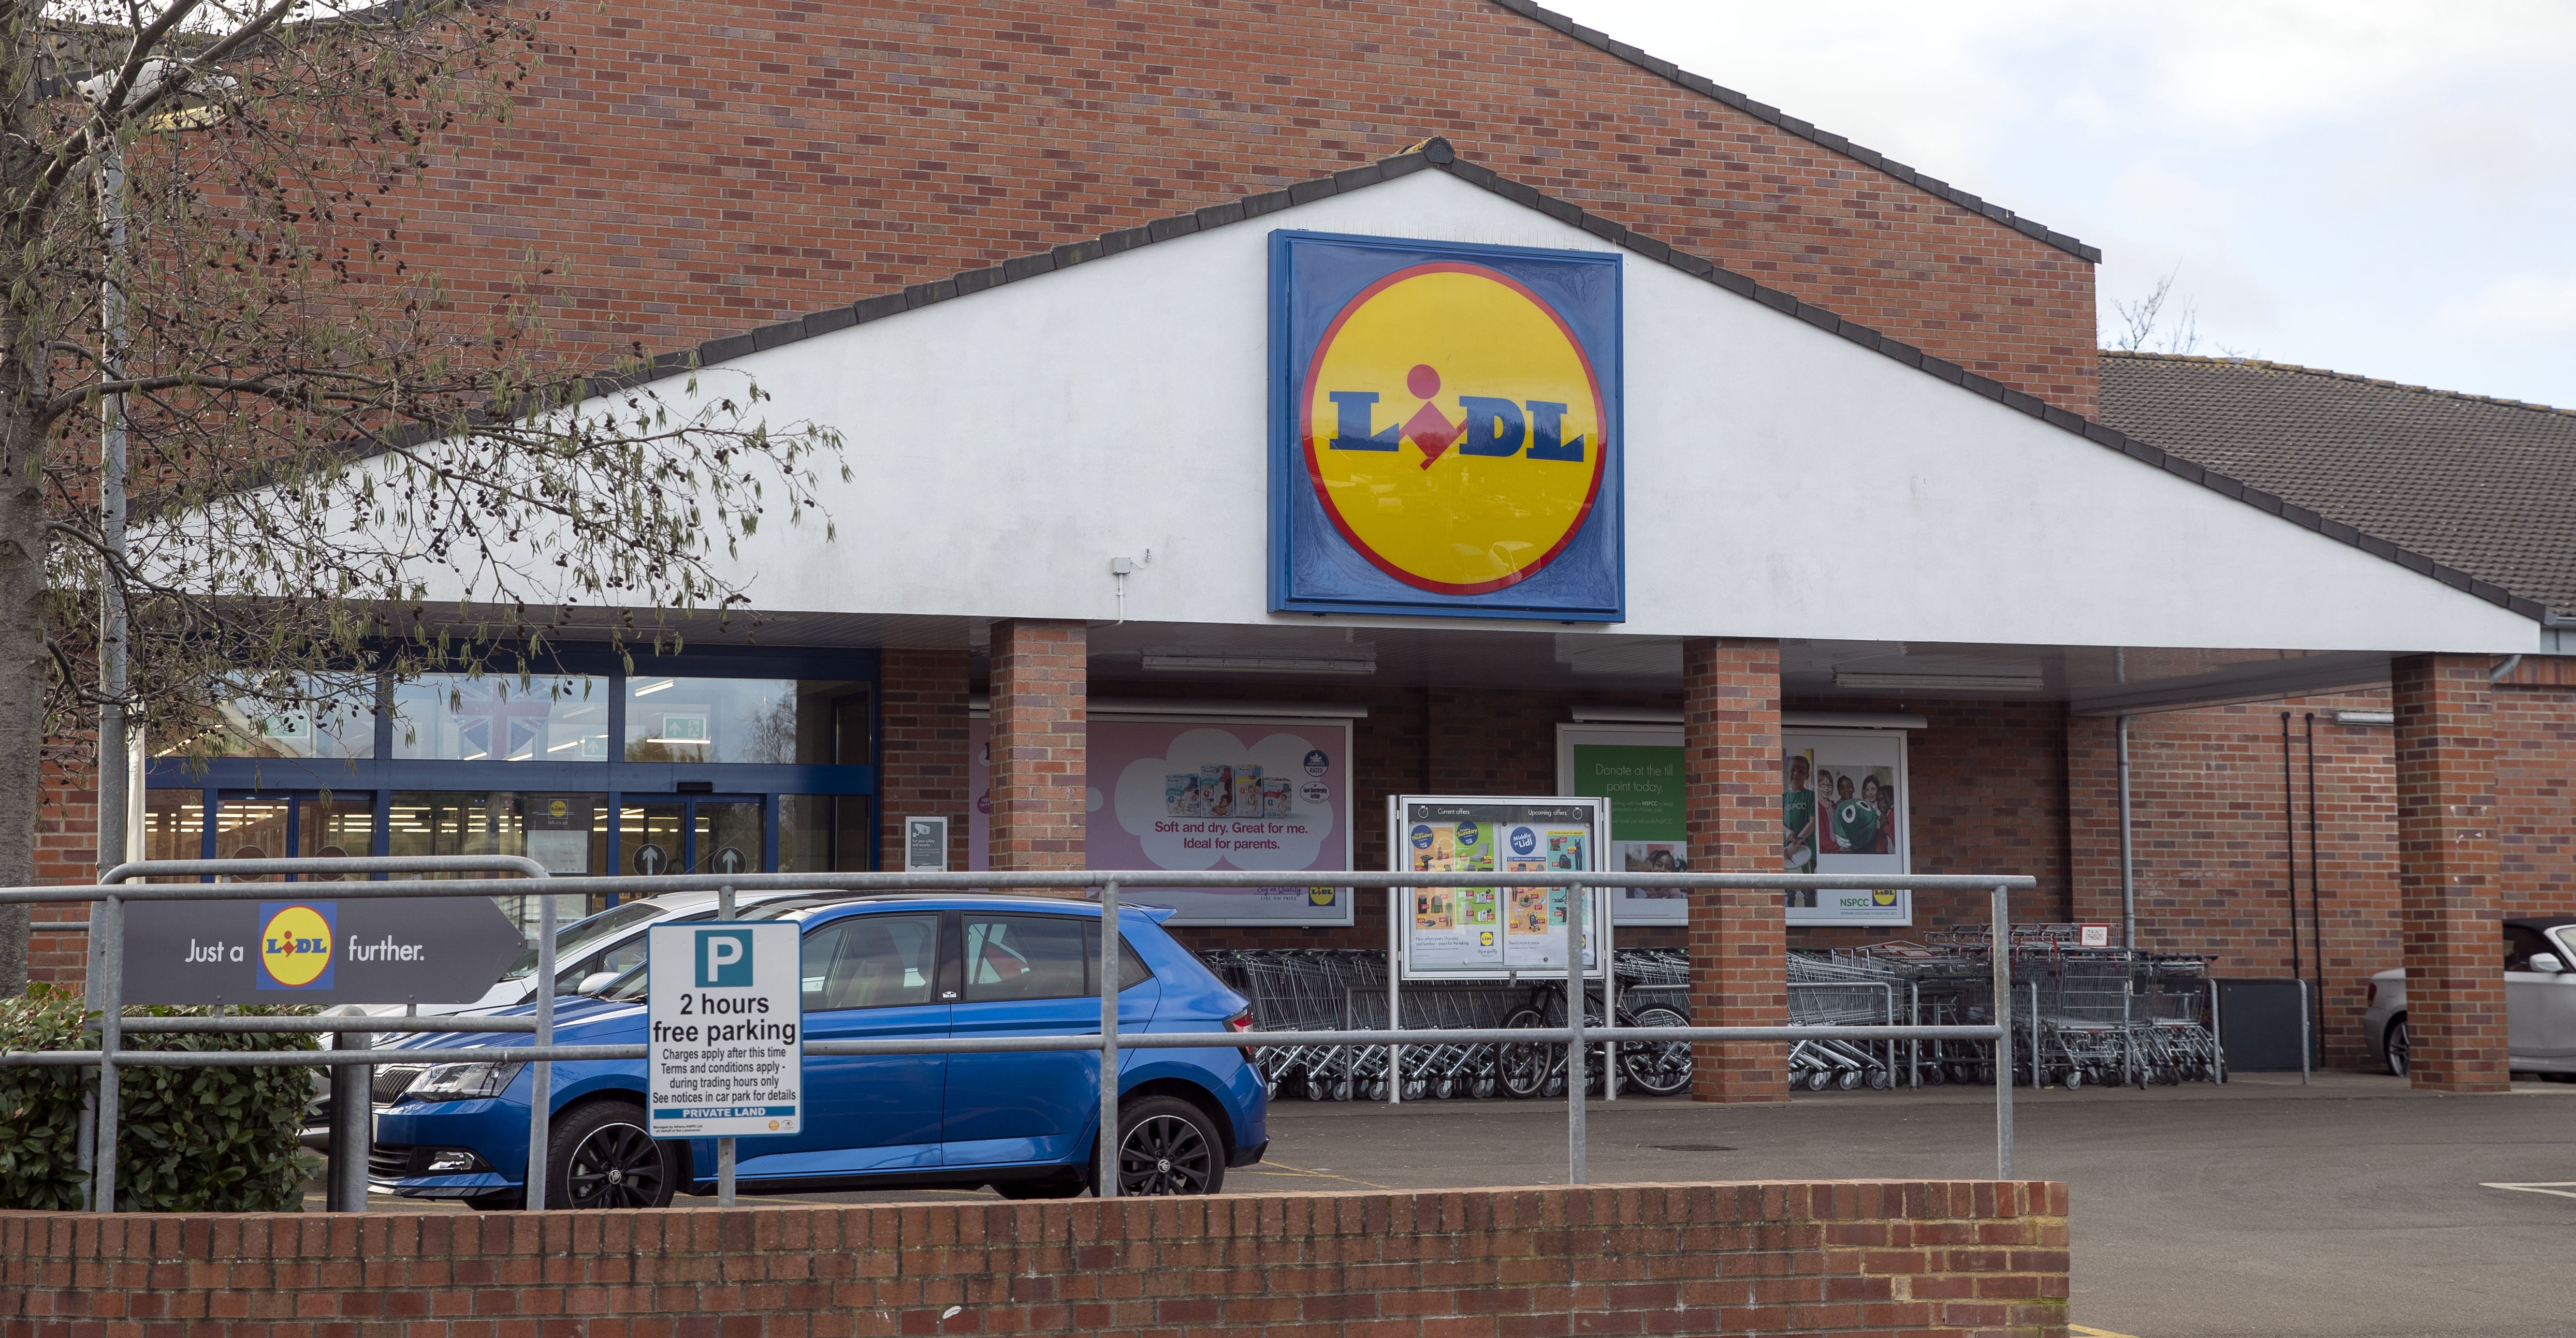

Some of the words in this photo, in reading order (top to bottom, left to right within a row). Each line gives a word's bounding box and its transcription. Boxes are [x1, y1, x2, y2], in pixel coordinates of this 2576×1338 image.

[1596, 763, 1631, 775] Donate
[1634, 766, 1643, 775] at
[1647, 763, 1662, 776] the
[1665, 764, 1673, 776] till
[1607, 782, 1630, 795] point
[1634, 780, 1664, 795] today.
[1784, 803, 1806, 811] NSPCC
[1155, 821, 1179, 833] Soft
[1183, 822, 1204, 833] and
[1207, 822, 1228, 835] dry.
[1232, 822, 1264, 833] Great
[1268, 823, 1284, 833] for
[1287, 824, 1308, 834] me.
[1457, 829, 1477, 837] Sunday
[1184, 837, 1211, 849] Ideal
[1214, 838, 1231, 849] for
[1234, 839, 1280, 851] parents.
[1513, 833, 1531, 842] Middle
[1518, 838, 1533, 848] Lidl
[1257, 887, 1268, 895] Big
[1278, 887, 1301, 896] Quality
[185, 938, 224, 963] Just
[229, 946, 244, 963] a
[348, 935, 425, 961] further.
[707, 936, 743, 982] P
[680, 994, 693, 1015] 2
[702, 993, 769, 1014] hours
[653, 1021, 698, 1042] free
[707, 1019, 796, 1047] parking
[663, 1049, 698, 1062] Charges
[701, 1048, 725, 1061] apply
[727, 1047, 747, 1058] after
[749, 1047, 765, 1057] this
[767, 1047, 786, 1057] time
[661, 1063, 688, 1075] Terms
[690, 1062, 706, 1074] and
[708, 1061, 754, 1073] conditions
[756, 1061, 780, 1074] apply
[670, 1077, 697, 1091] during
[700, 1076, 731, 1090] trading
[733, 1076, 758, 1087] hours
[761, 1075, 779, 1089] only
[652, 1092, 669, 1104] See
[671, 1092, 703, 1103] notices
[705, 1091, 714, 1102] in
[716, 1093, 729, 1102] car
[732, 1090, 751, 1104] park
[753, 1090, 766, 1101] for
[767, 1089, 796, 1100] details
[682, 1108, 732, 1118] PRIVATE
[734, 1107, 766, 1117] LAND
